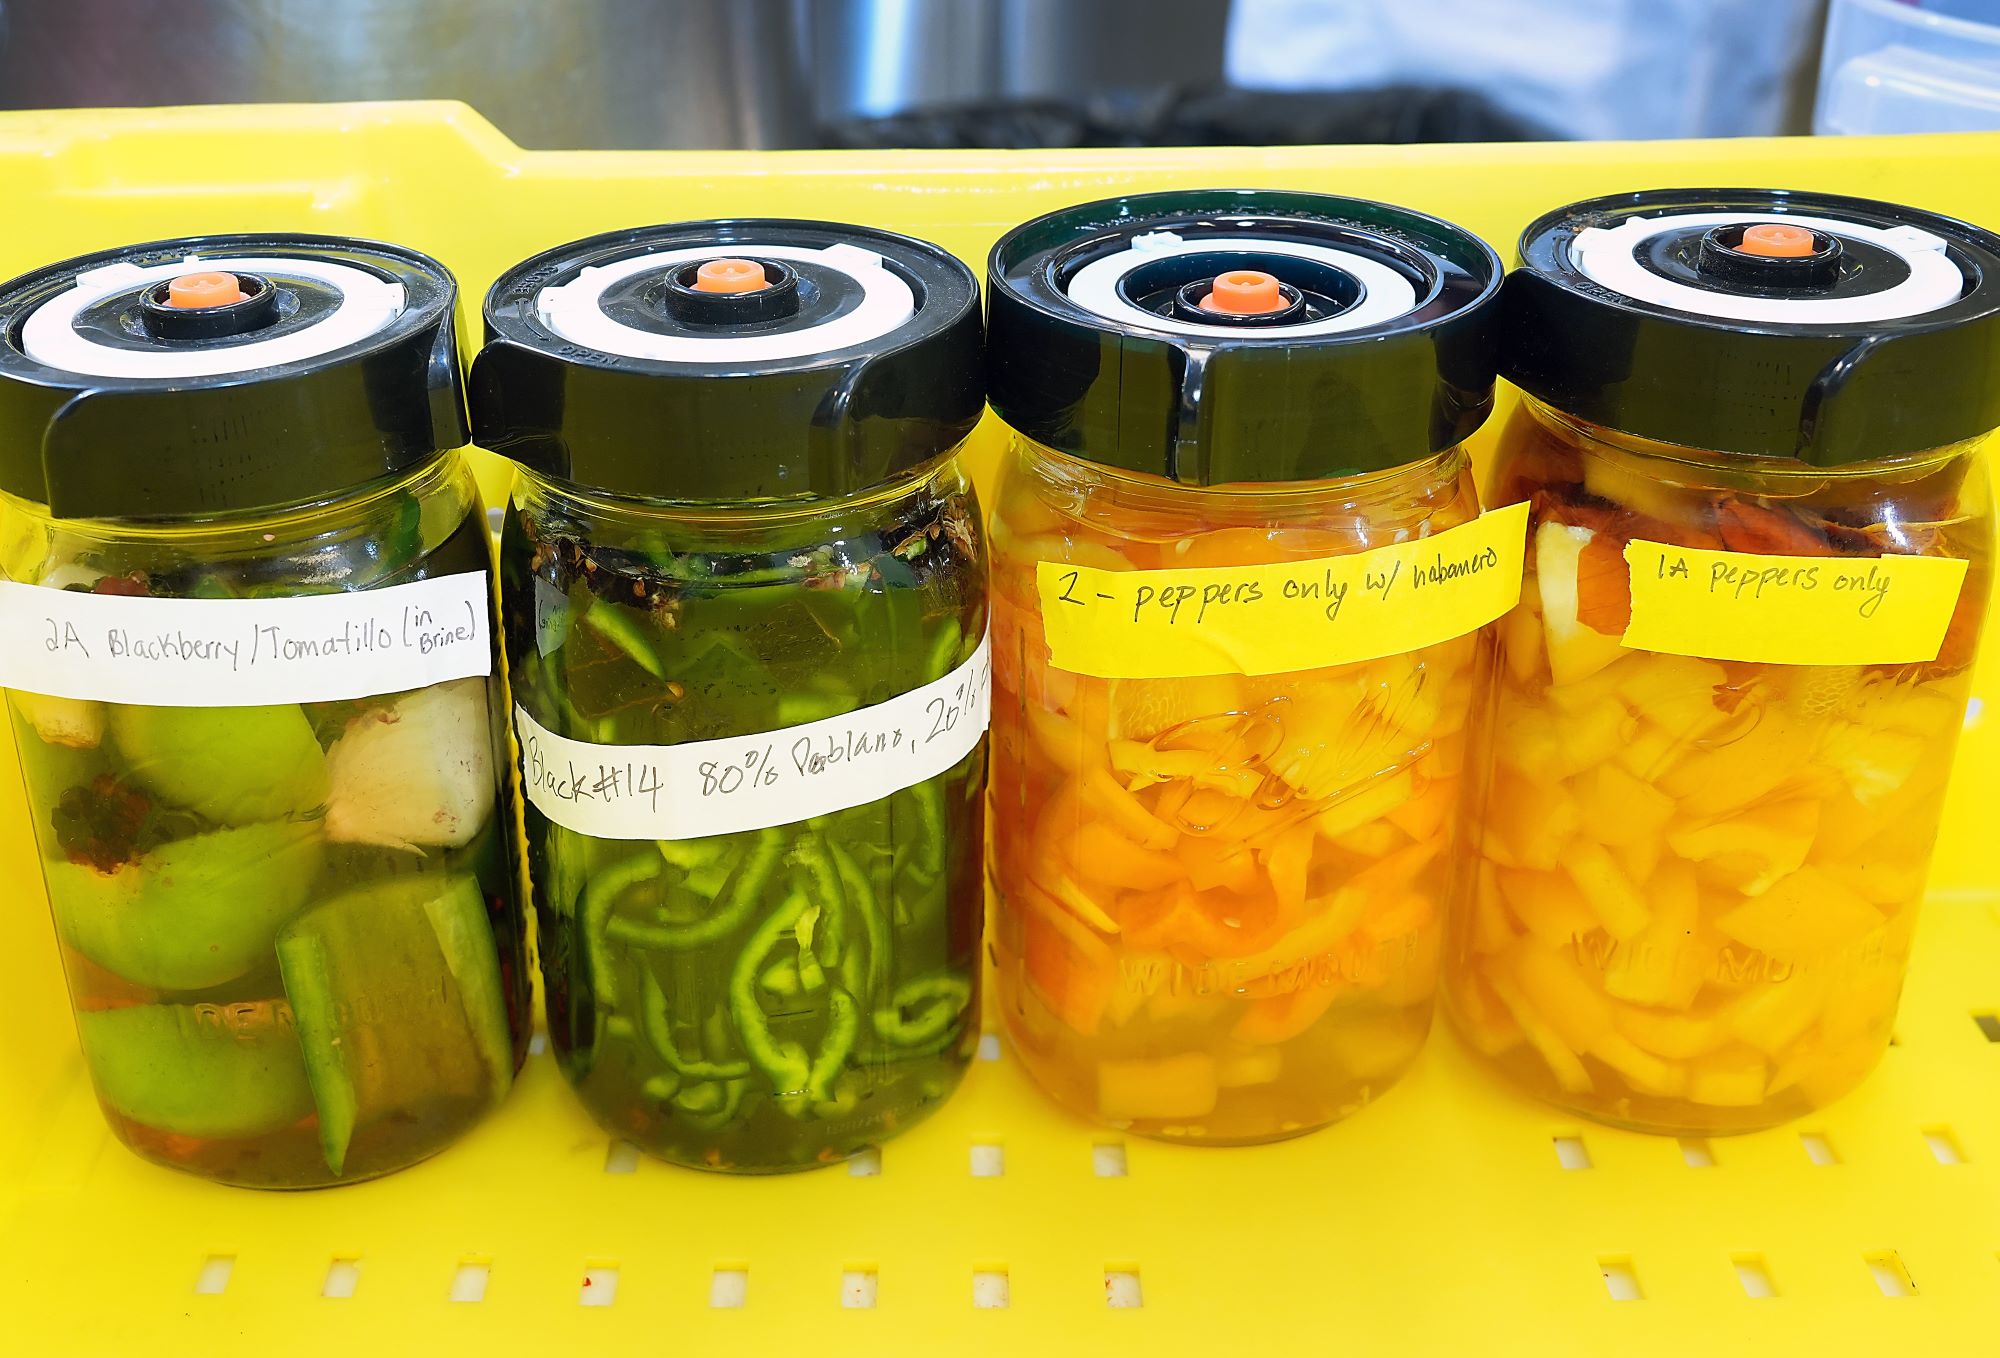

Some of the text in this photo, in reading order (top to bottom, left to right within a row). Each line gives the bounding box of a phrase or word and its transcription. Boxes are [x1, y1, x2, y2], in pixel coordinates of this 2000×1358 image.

[1133, 581, 1264, 625] peppers
[1282, 568, 1348, 622] only
[1365, 559, 1401, 601] w/
[1412, 546, 1498, 590] habanero
[1711, 561, 1818, 599] peppers
[1833, 565, 1892, 618] only
[698, 743, 780, 797] 80%
[924, 667, 978, 744] 20%
